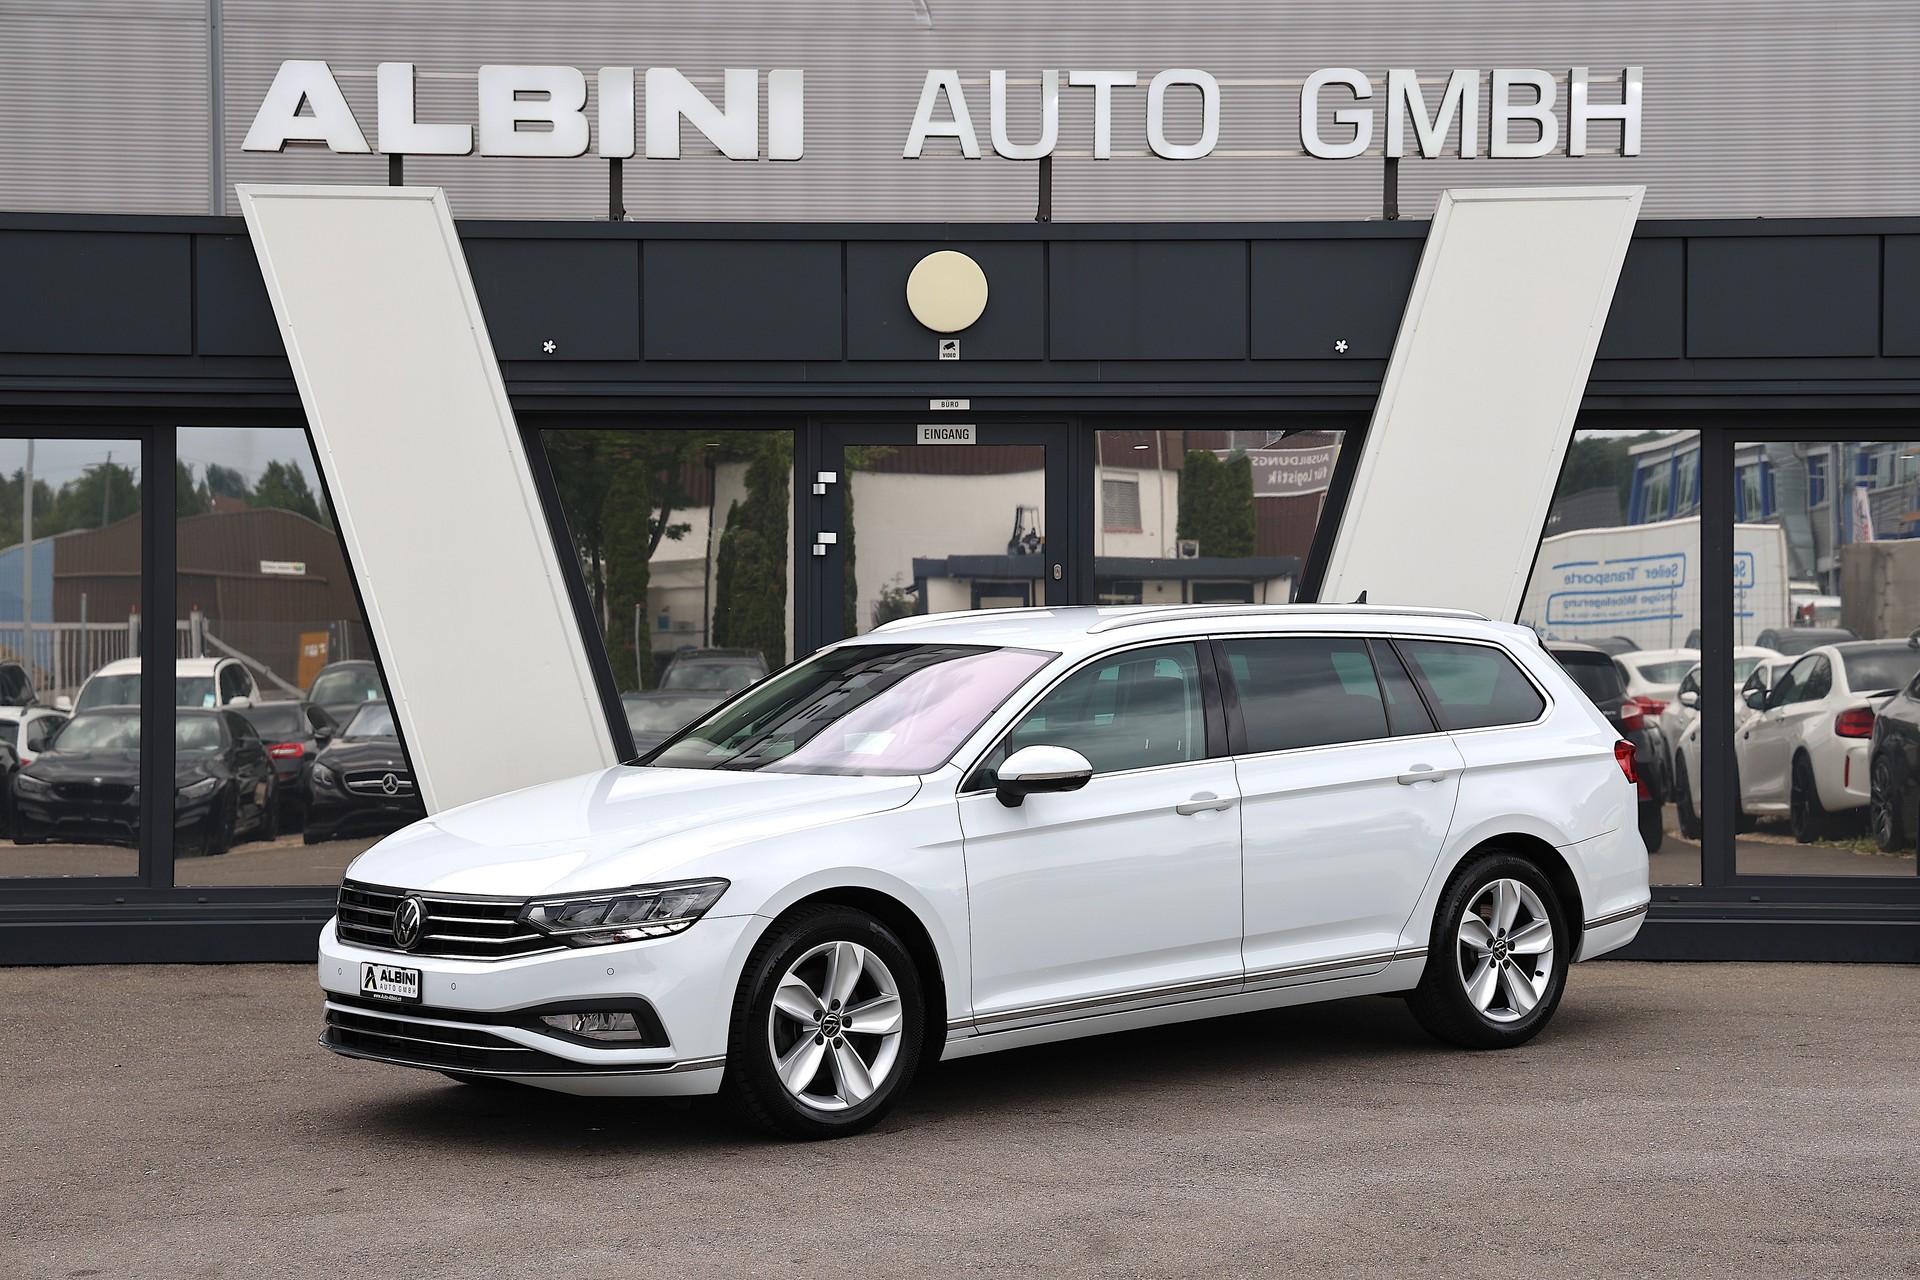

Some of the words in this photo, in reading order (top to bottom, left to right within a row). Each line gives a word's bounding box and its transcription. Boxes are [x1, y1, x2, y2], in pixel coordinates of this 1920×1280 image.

[240, 59, 805, 162] ALBINI
[902, 68, 1221, 161] AUTO
[1300, 66, 1644, 160] GMBH
[941, 400, 959, 408] BÜRO
[924, 428, 970, 440] EINGANG
[380, 969, 416, 986] ALBINI
[380, 983, 396, 992] AUTO
[398, 985, 416, 994] GMBH
